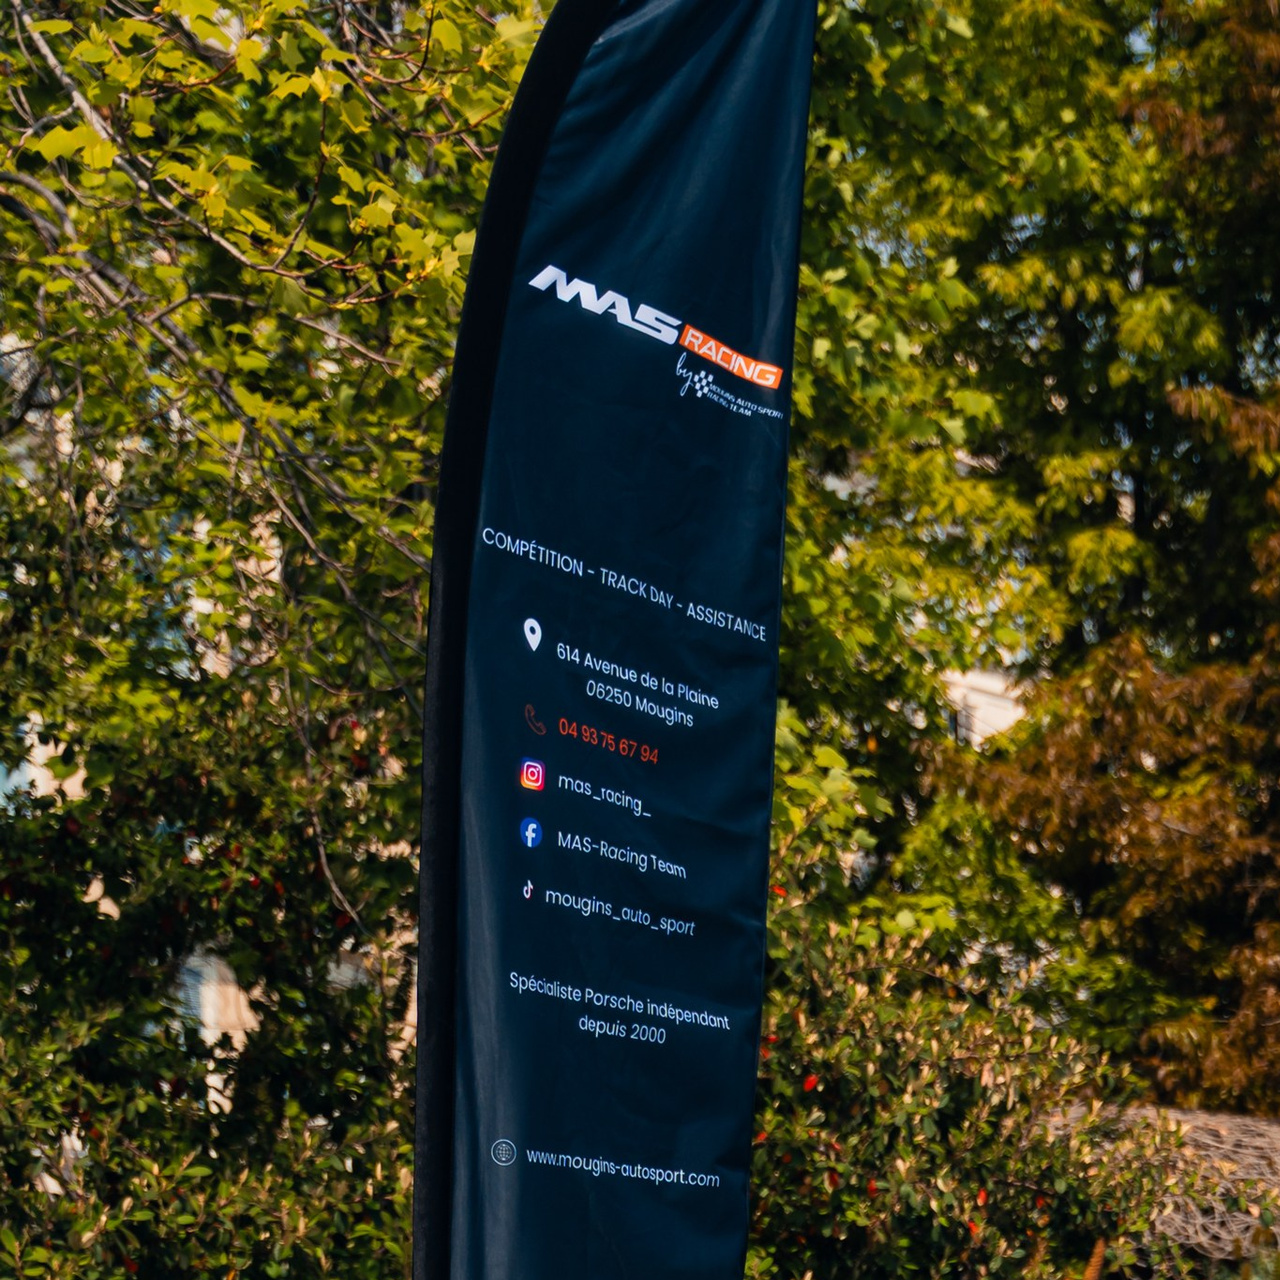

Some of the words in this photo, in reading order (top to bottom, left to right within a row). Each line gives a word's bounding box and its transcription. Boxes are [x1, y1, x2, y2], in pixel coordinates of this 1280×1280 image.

[528, 265, 682, 345] MAS
[684, 329, 777, 386] RACING
[675, 352, 694, 396] by
[729, 403, 752, 417] TEAM
[736, 398, 757, 411] AUTO
[482, 527, 583, 577] COMPÉTITION
[600, 567, 647, 598] TRACK
[650, 585, 673, 609] DAY
[686, 602, 767, 642] ASSISTANCE
[557, 642, 580, 664] 614
[584, 653, 638, 682] Avenue
[640, 672, 658, 690] de
[661, 677, 674, 696] la
[677, 683, 719, 709] Plaine
[586, 680, 631, 707] 06250
[635, 695, 694, 727] Mougins
[559, 717, 578, 739] 04
[581, 725, 598, 745] 93
[600, 731, 616, 751] 75
[619, 739, 637, 757] 67
[640, 745, 659, 765] 94
[558, 775, 652, 817] mas_racing_
[558, 831, 648, 872] MAS-Racing
[650, 854, 687, 879] Team
[546, 890, 696, 936] mougins_auto_sport
[510, 971, 582, 1002] Spécialiste
[585, 988, 644, 1013] Porsche
[647, 999, 730, 1030] indépendant
[579, 1015, 626, 1038] depuis
[630, 1023, 666, 1044] 2000
[526, 1149, 720, 1187] www.mougins-autosport.com
